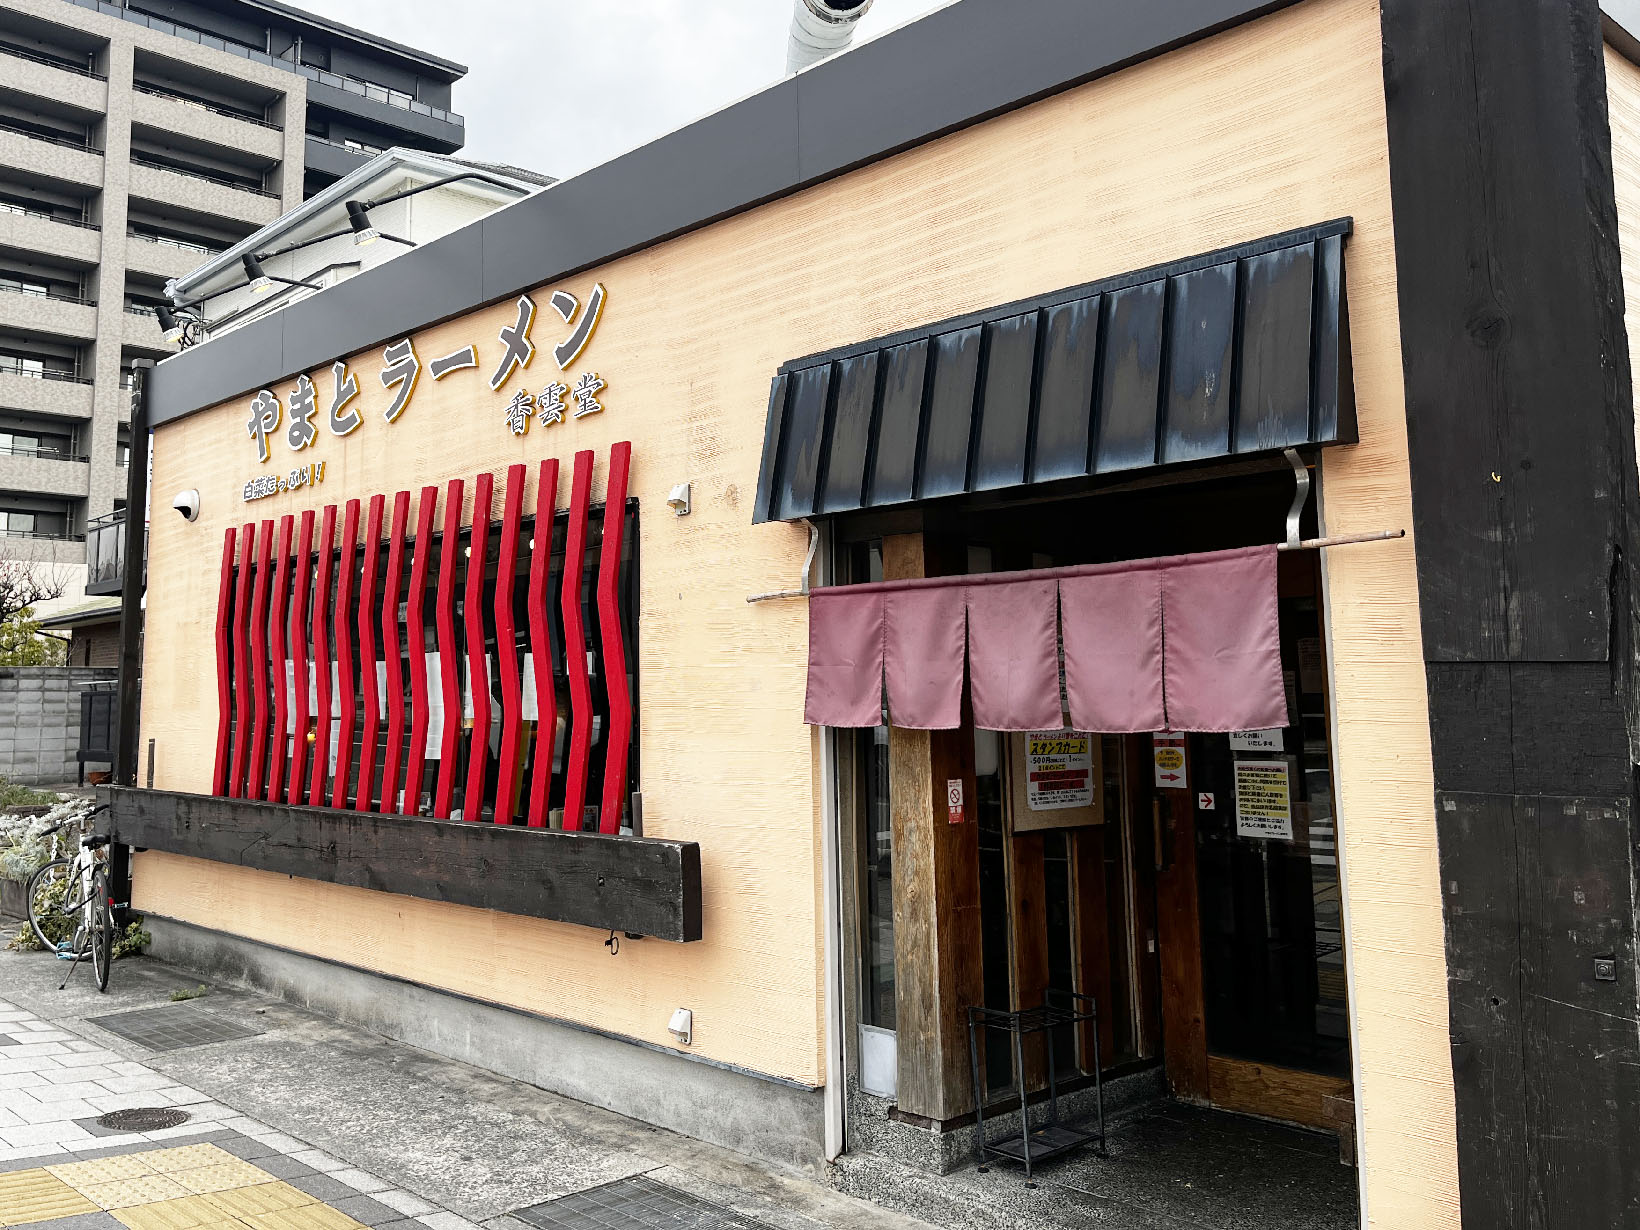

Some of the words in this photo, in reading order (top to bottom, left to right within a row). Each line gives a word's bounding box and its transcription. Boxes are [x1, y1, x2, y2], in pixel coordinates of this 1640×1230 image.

[248, 283, 608, 462] やまとラーメン
[505, 372, 608, 435] 香雲堂
